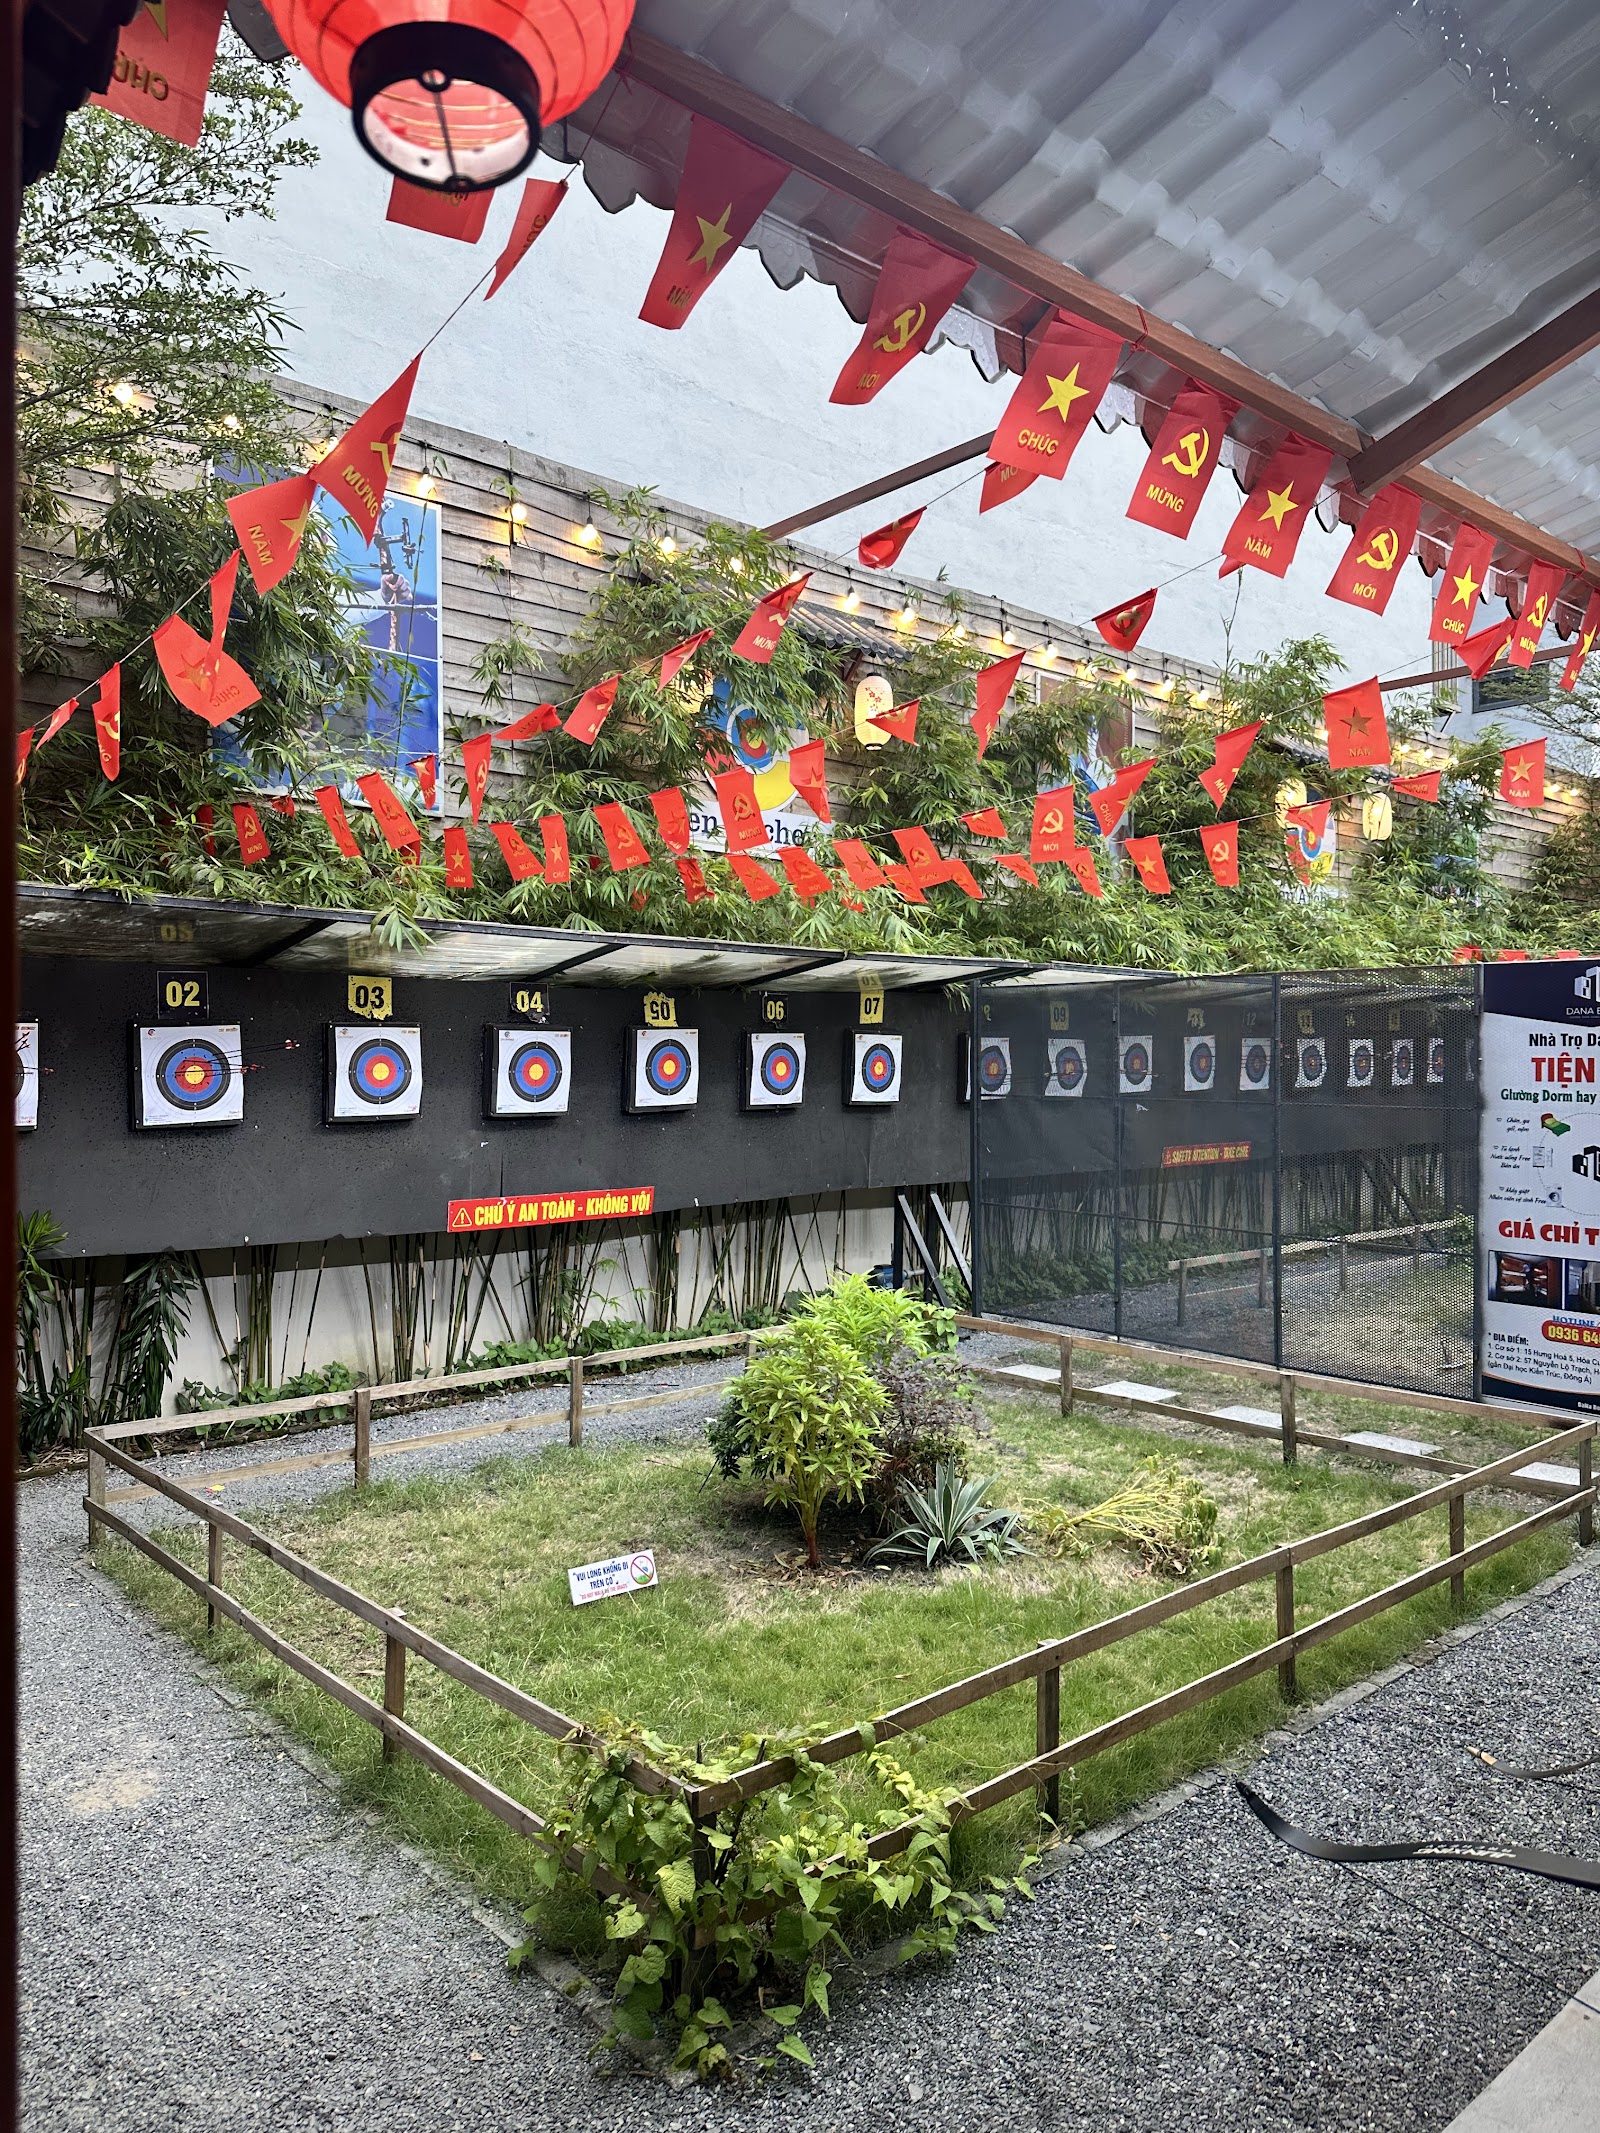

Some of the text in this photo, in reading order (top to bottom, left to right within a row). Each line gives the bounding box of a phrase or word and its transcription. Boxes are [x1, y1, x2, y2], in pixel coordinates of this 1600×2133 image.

[1018, 428, 1059, 455] CHÚC
[342, 463, 380, 519] MỪNG
[1145, 484, 1184, 513] MỪNG
[247, 523, 274, 567] NĂM
[1244, 536, 1272, 559] NĂM
[1352, 582, 1378, 600] MỚI
[1442, 617, 1465, 635] CHÚC
[1508, 788, 1530, 798] NĂM
[1099, 801, 1114, 827] CHÚC
[1042, 842, 1059, 851] MỚI
[166, 981, 200, 1007] 02
[355, 985, 385, 1009] 03
[517, 990, 544, 1013] 04
[767, 1000, 785, 1020] 06
[864, 997, 880, 1015] 07
[1566, 1007, 1594, 1016] DANA
[1529, 1033, 1556, 1047] Nhà
[1560, 1033, 1583, 1050] Trọ
[1531, 1051, 1595, 1088] TIỆN
[1542, 1089, 1573, 1102] Dorm
[1576, 1090, 1597, 1105] hay
[1172, 1149, 1192, 1164] SAFETY
[474, 1201, 503, 1226] CHÚ
[506, 1201, 515, 1223] Ý
[518, 1203, 539, 1222] AN
[541, 1197, 575, 1220] TOÀN
[586, 1193, 629, 1216] KHÔNG
[631, 1190, 651, 1215] VỘI
[1498, 1217, 1535, 1240] GIÁ
[1540, 1221, 1580, 1244] CHỈ
[1552, 1315, 1595, 1328] HOTLINE
[1548, 1325, 1600, 1345] 0936 64
